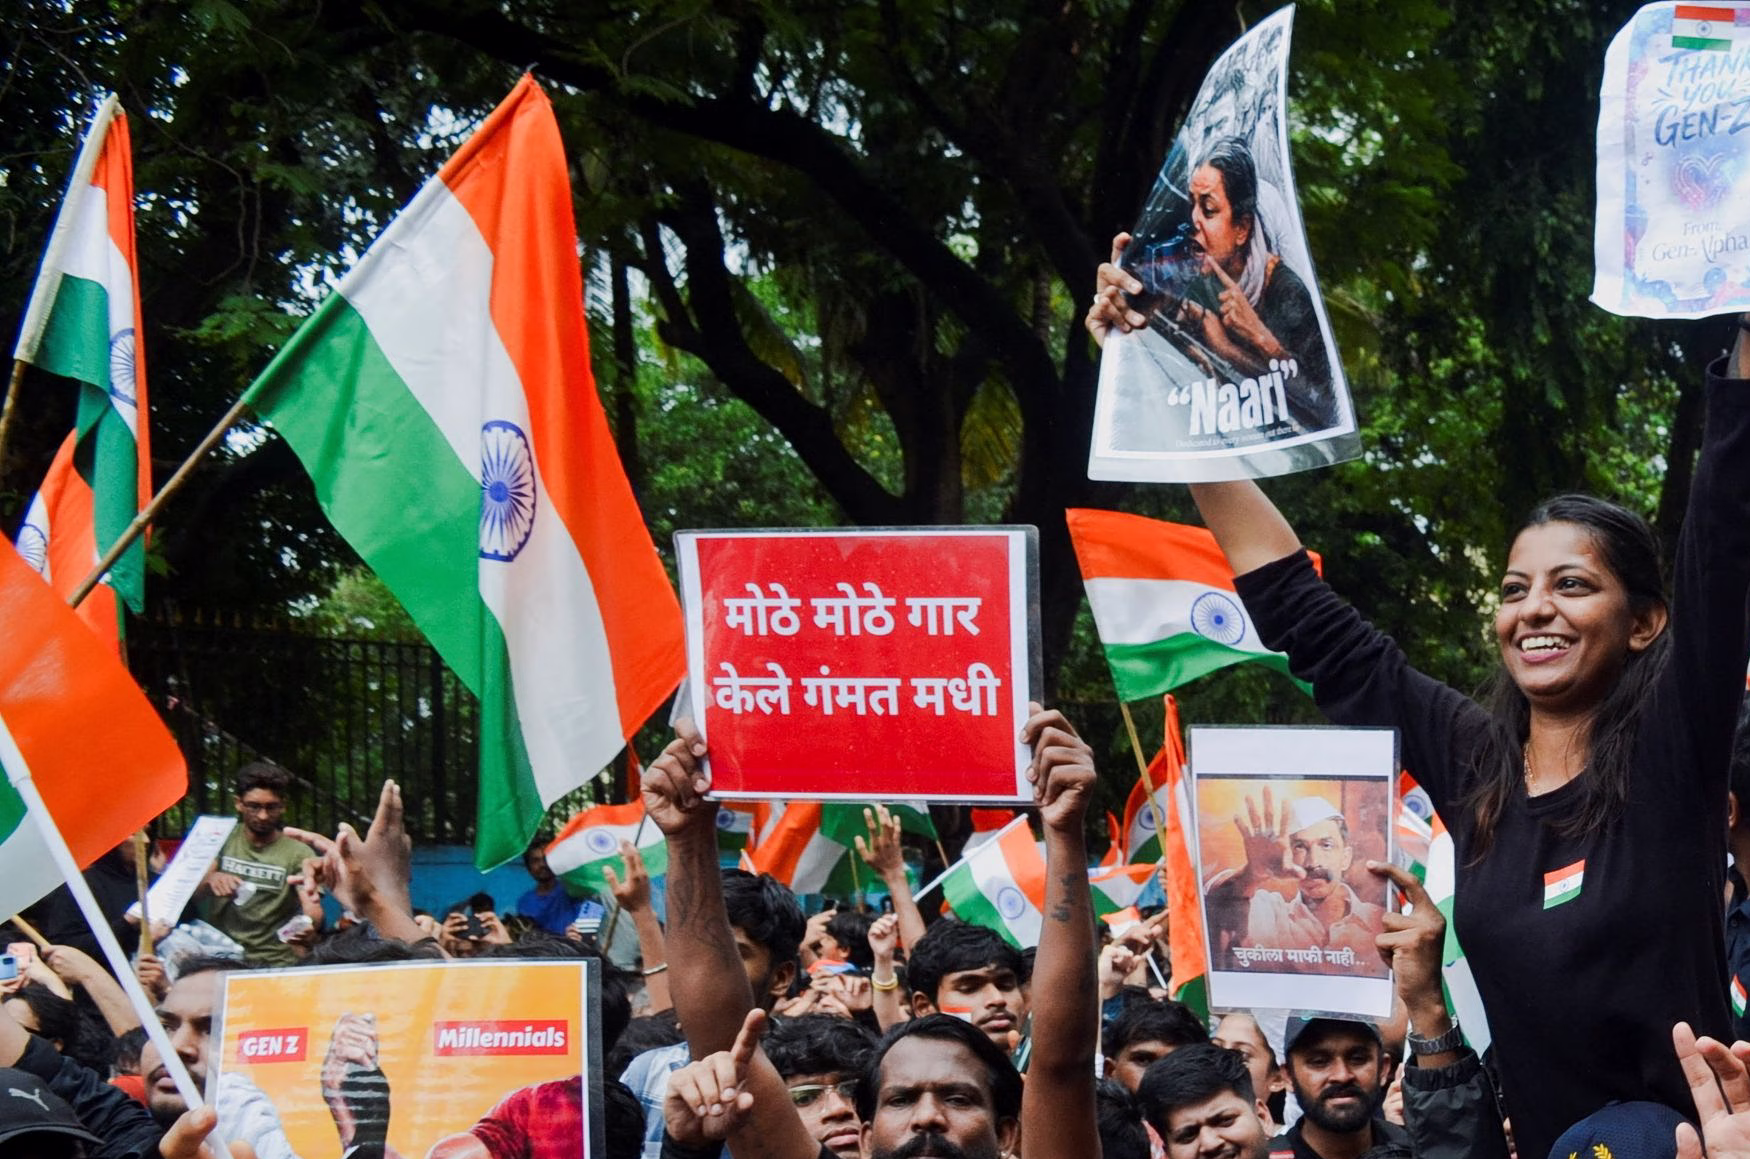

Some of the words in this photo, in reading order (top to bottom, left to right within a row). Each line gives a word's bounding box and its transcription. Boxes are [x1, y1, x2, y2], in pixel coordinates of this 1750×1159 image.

[723, 582, 801, 636] मोठे
[810, 582, 896, 636] मोठे
[905, 597, 982, 636] गार
[713, 662, 792, 715] केले
[800, 665, 901, 716] गंमत
[910, 662, 1001, 716] मधी
[1232, 943, 1283, 967] चुकीला
[1286, 945, 1322, 964] माफी
[243, 1036, 282, 1057] GEN
[283, 1035, 300, 1055] Z
[438, 1026, 565, 1049] Millennials
